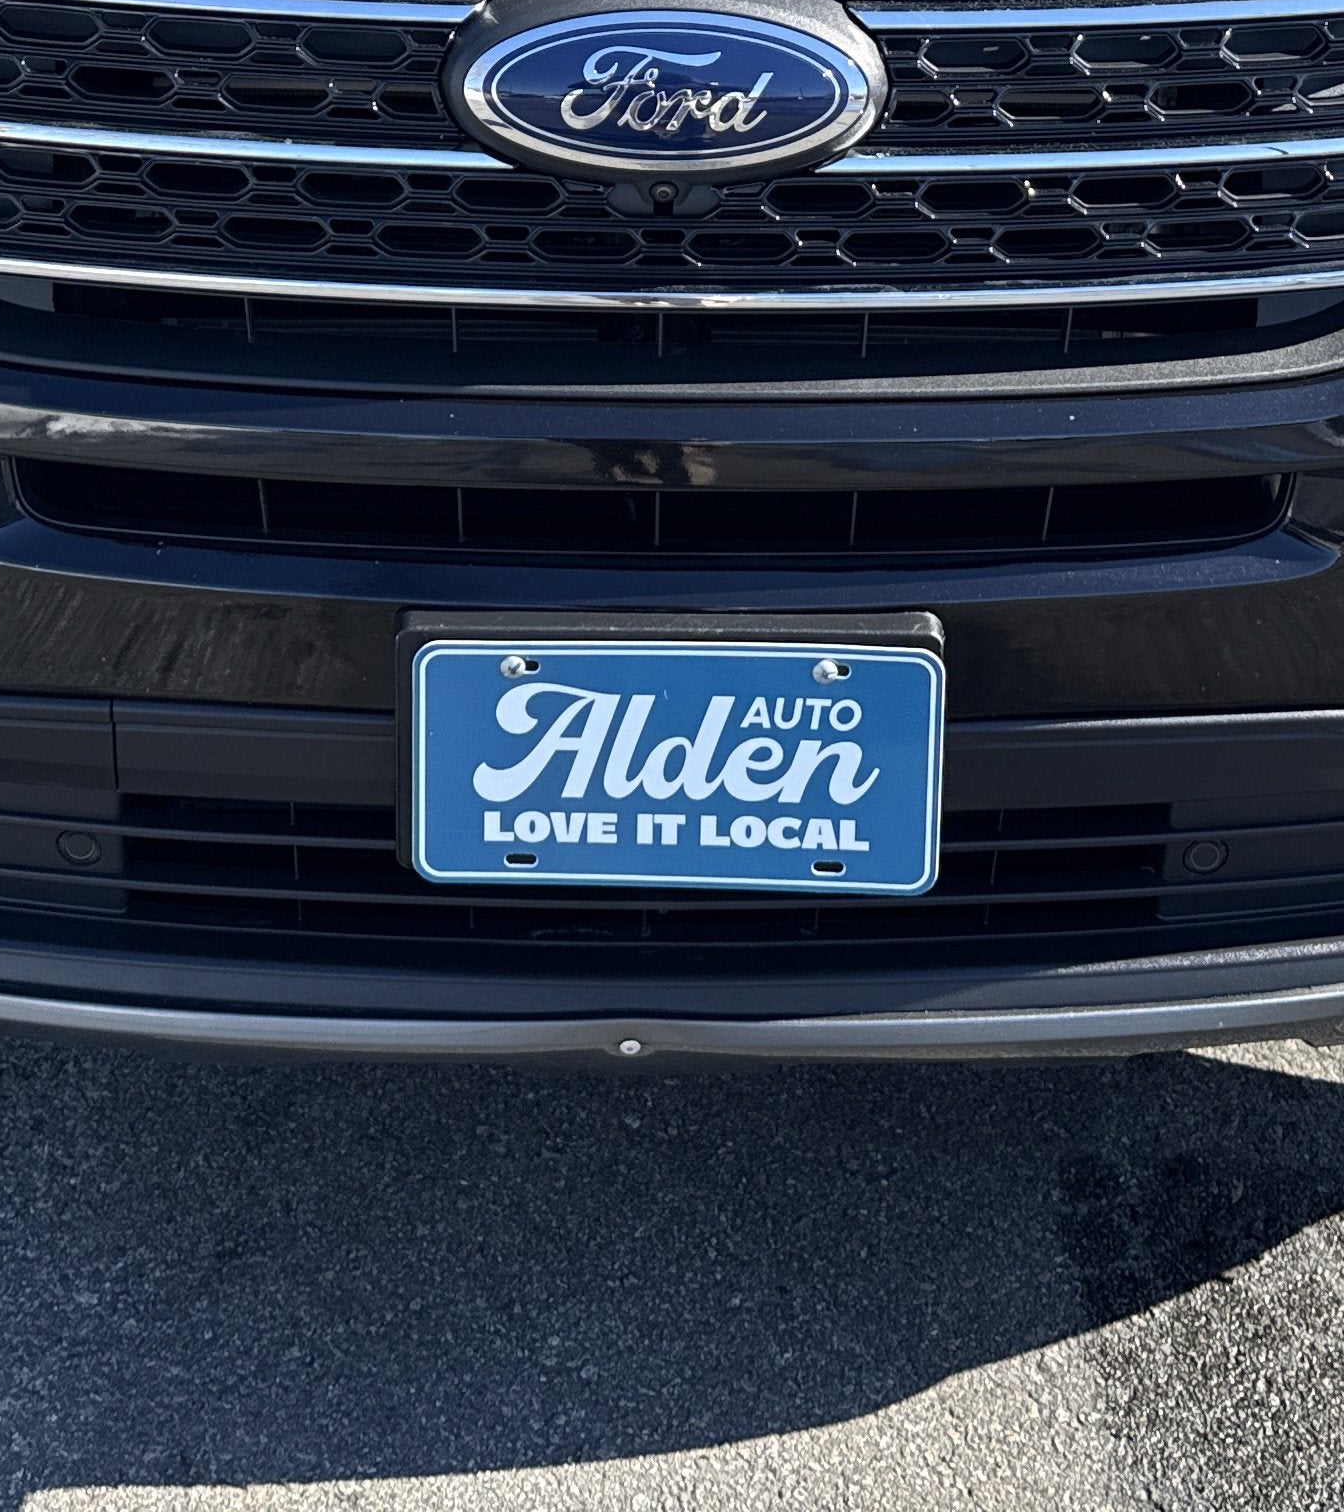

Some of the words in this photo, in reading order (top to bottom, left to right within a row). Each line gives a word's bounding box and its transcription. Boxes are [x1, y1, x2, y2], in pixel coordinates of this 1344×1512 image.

[560, 45, 775, 134] Ford
[472, 682, 880, 806] Alden
[739, 697, 863, 732] AUTO
[483, 810, 620, 845] LOVE
[636, 813, 686, 848] IT
[699, 815, 871, 852] LOCAL
